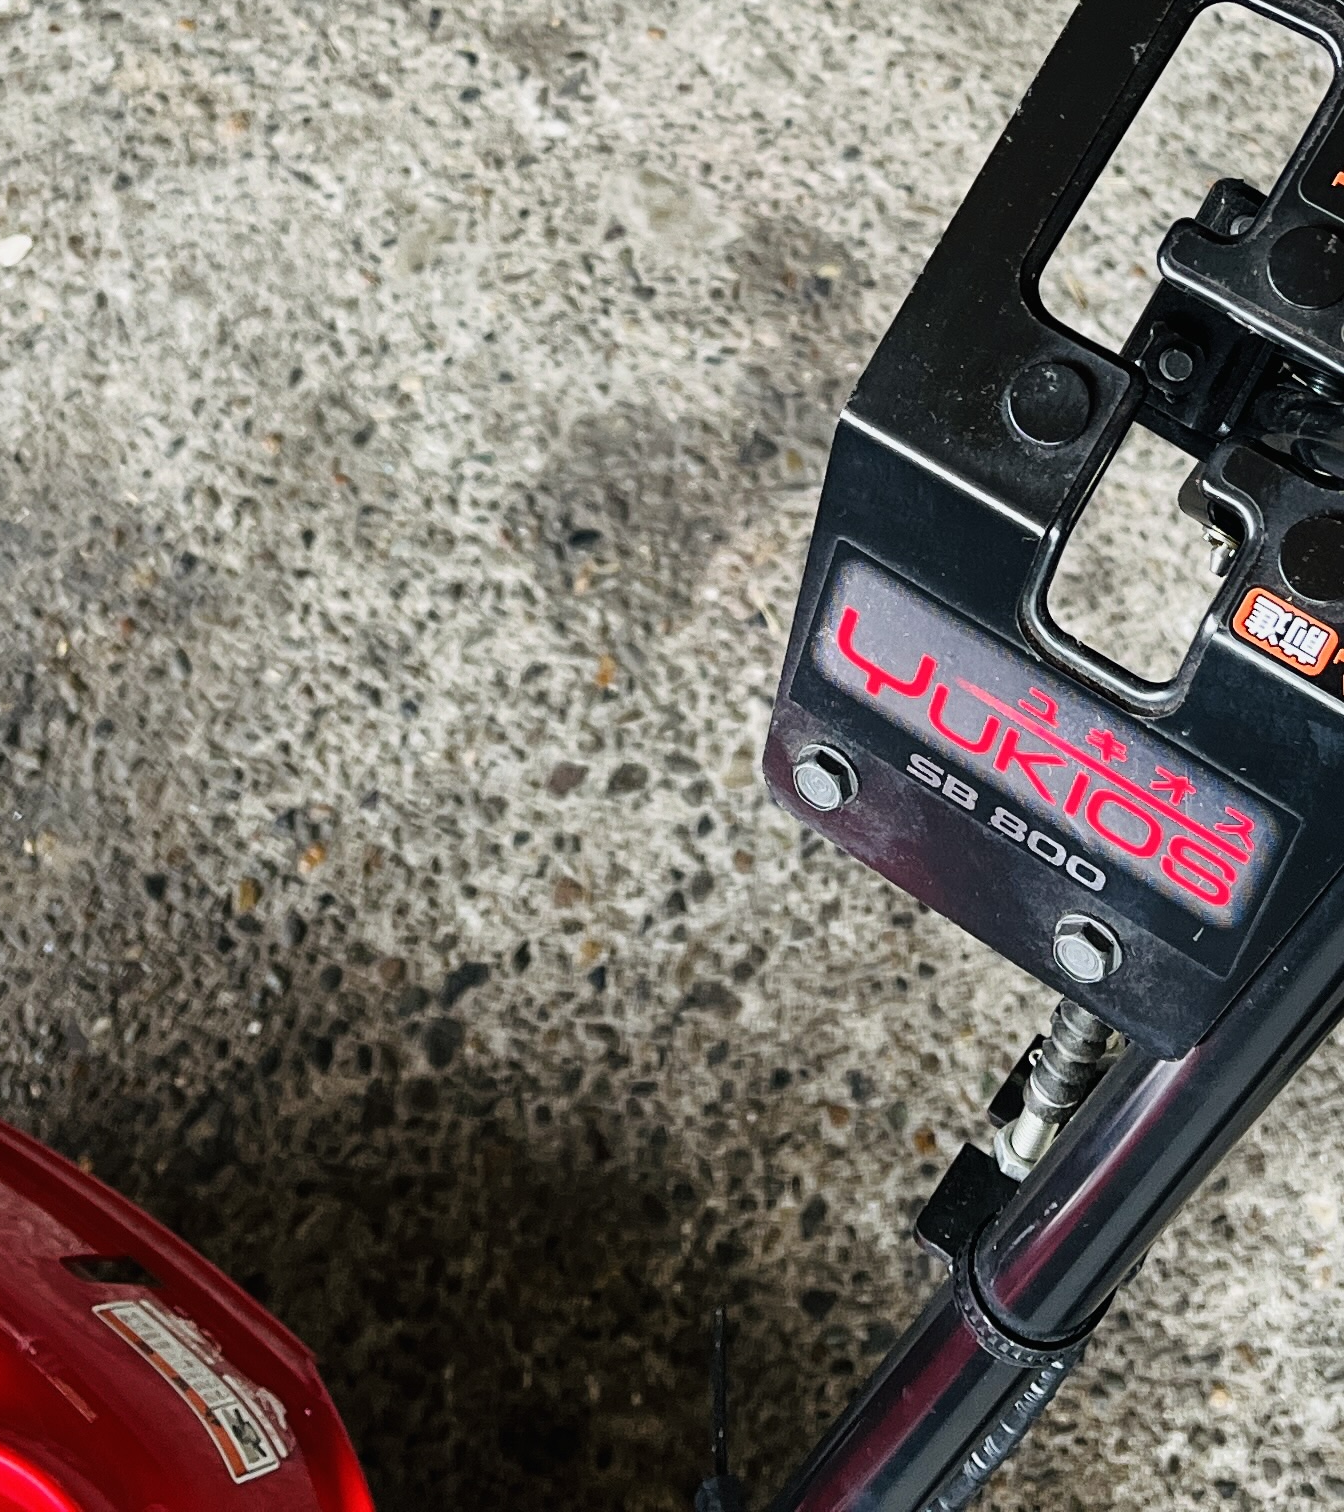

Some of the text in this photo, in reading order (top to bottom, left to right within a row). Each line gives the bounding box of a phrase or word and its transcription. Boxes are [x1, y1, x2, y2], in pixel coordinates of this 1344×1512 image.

[1243, 593, 1329, 668] 前進
[904, 752, 1107, 892] SB 800
[1020, 686, 1255, 851] ユキオス
